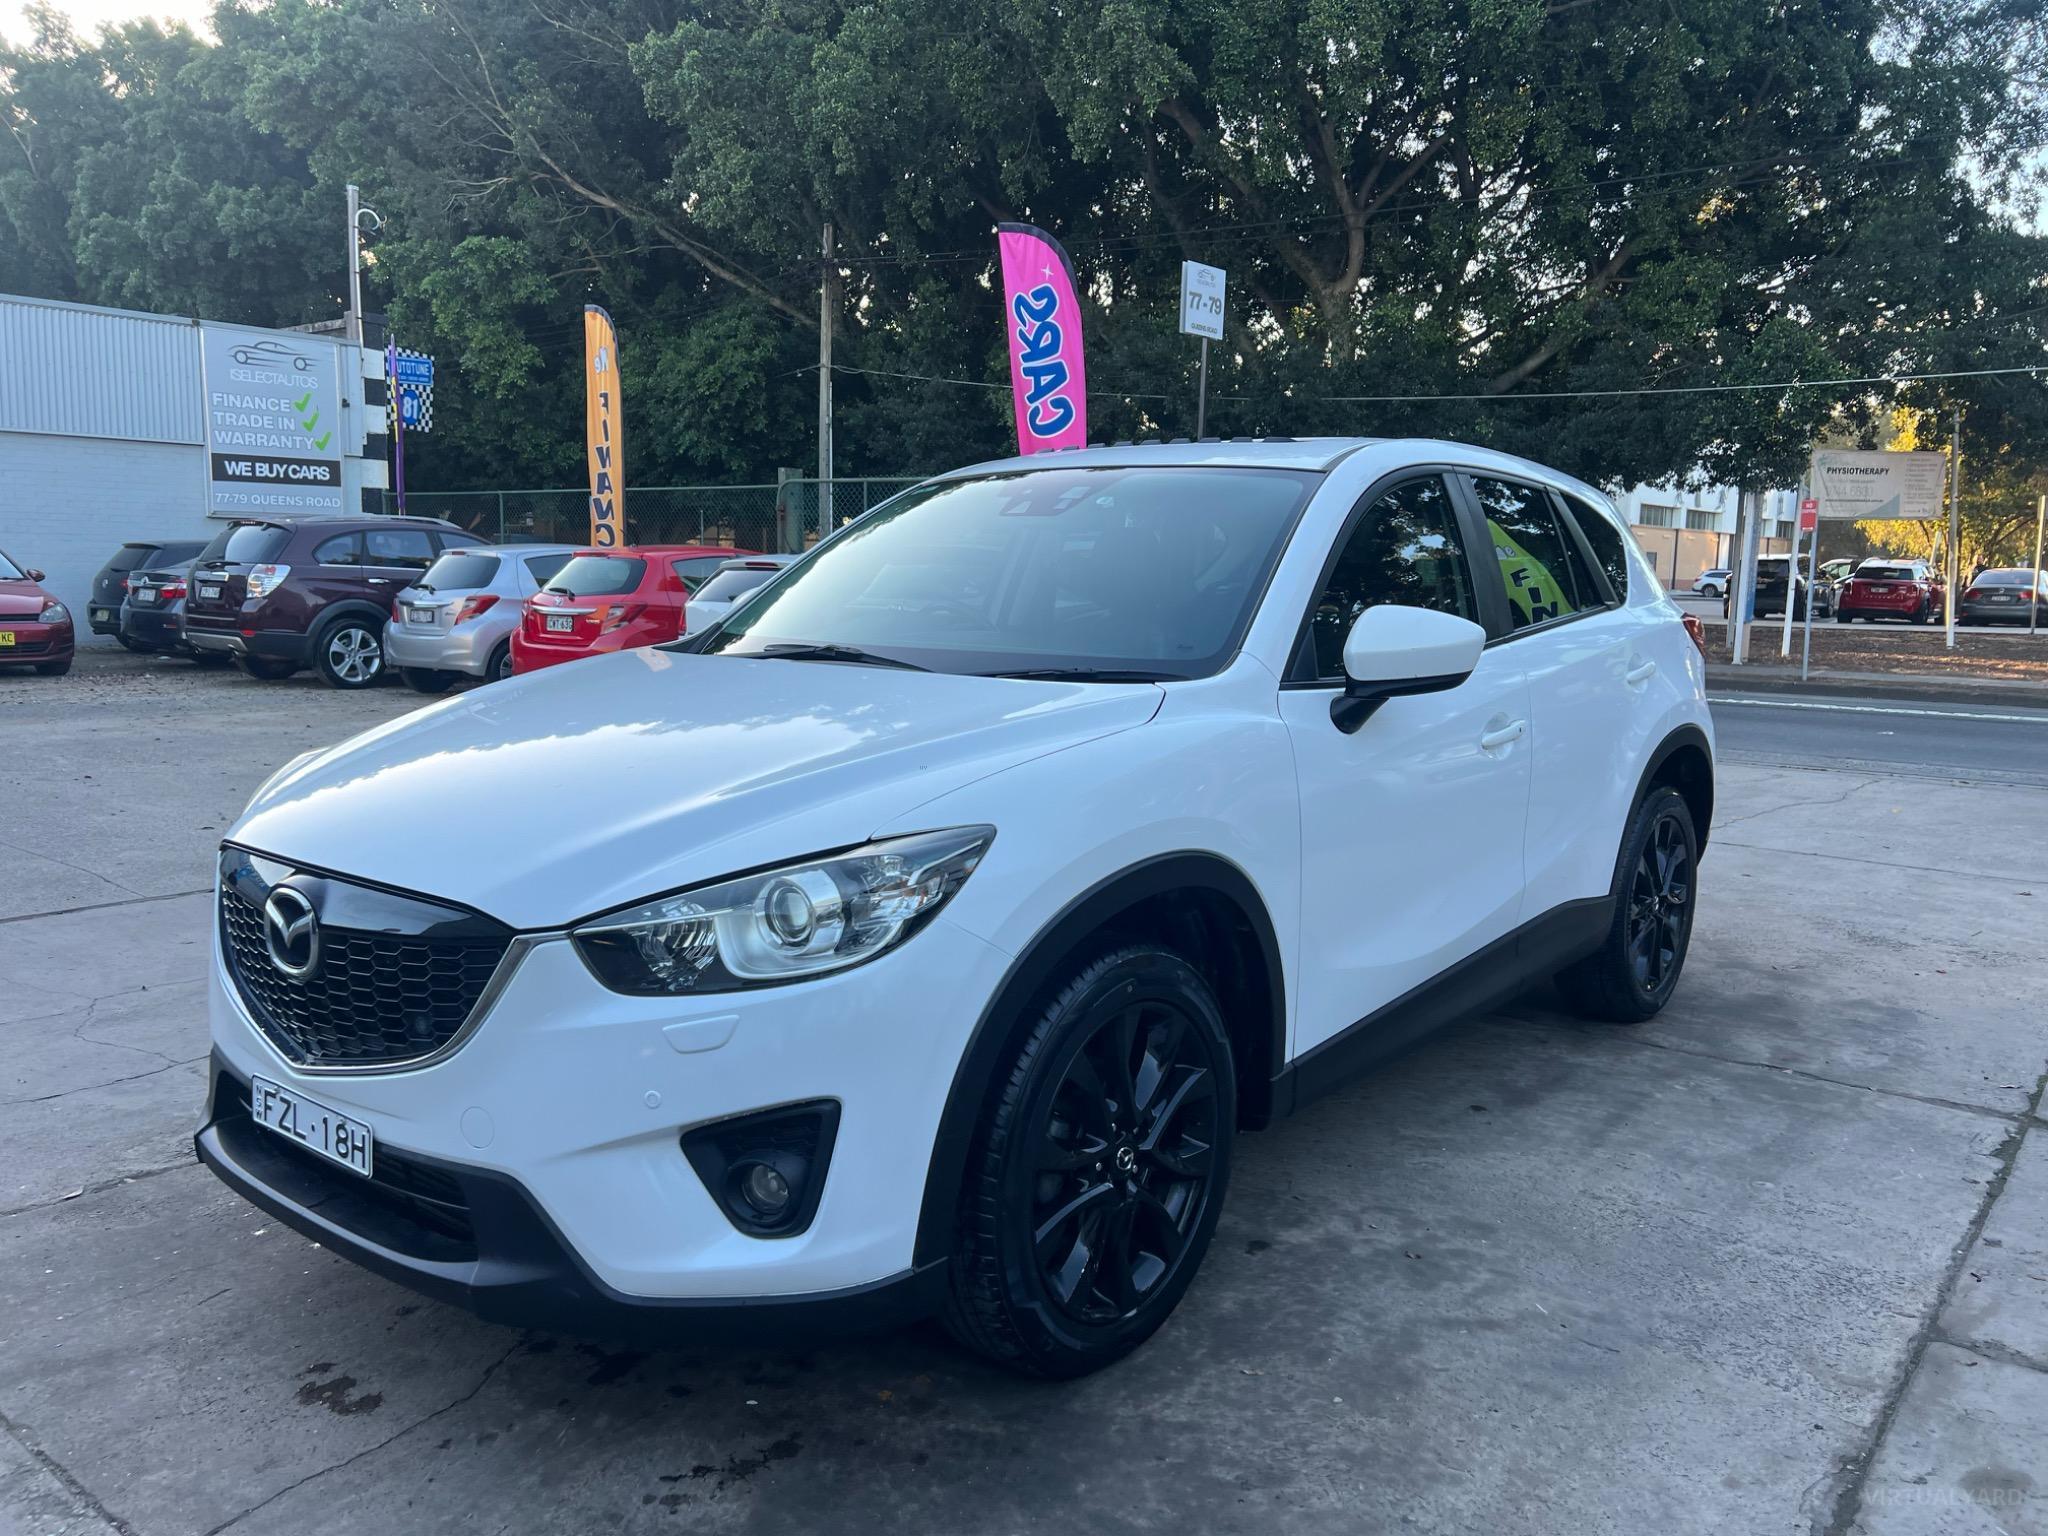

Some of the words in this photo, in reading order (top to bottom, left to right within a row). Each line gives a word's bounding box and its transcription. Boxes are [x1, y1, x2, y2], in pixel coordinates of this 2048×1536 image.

[395, 361, 430, 375] UTOTUNE
[212, 392, 291, 412] FINANCE
[403, 396, 418, 419] 81
[213, 411, 275, 429] TRADE
[278, 416, 296, 431] IN
[214, 430, 315, 450] WARRANTY
[224, 460, 252, 476] WE
[255, 462, 288, 479] BUY
[288, 465, 330, 480] CARS
[1826, 466, 1890, 475] PHYSIOTHERAPY
[215, 493, 248, 503] 77-79
[251, 494, 303, 506] QUEENS
[306, 497, 340, 508] ROAD
